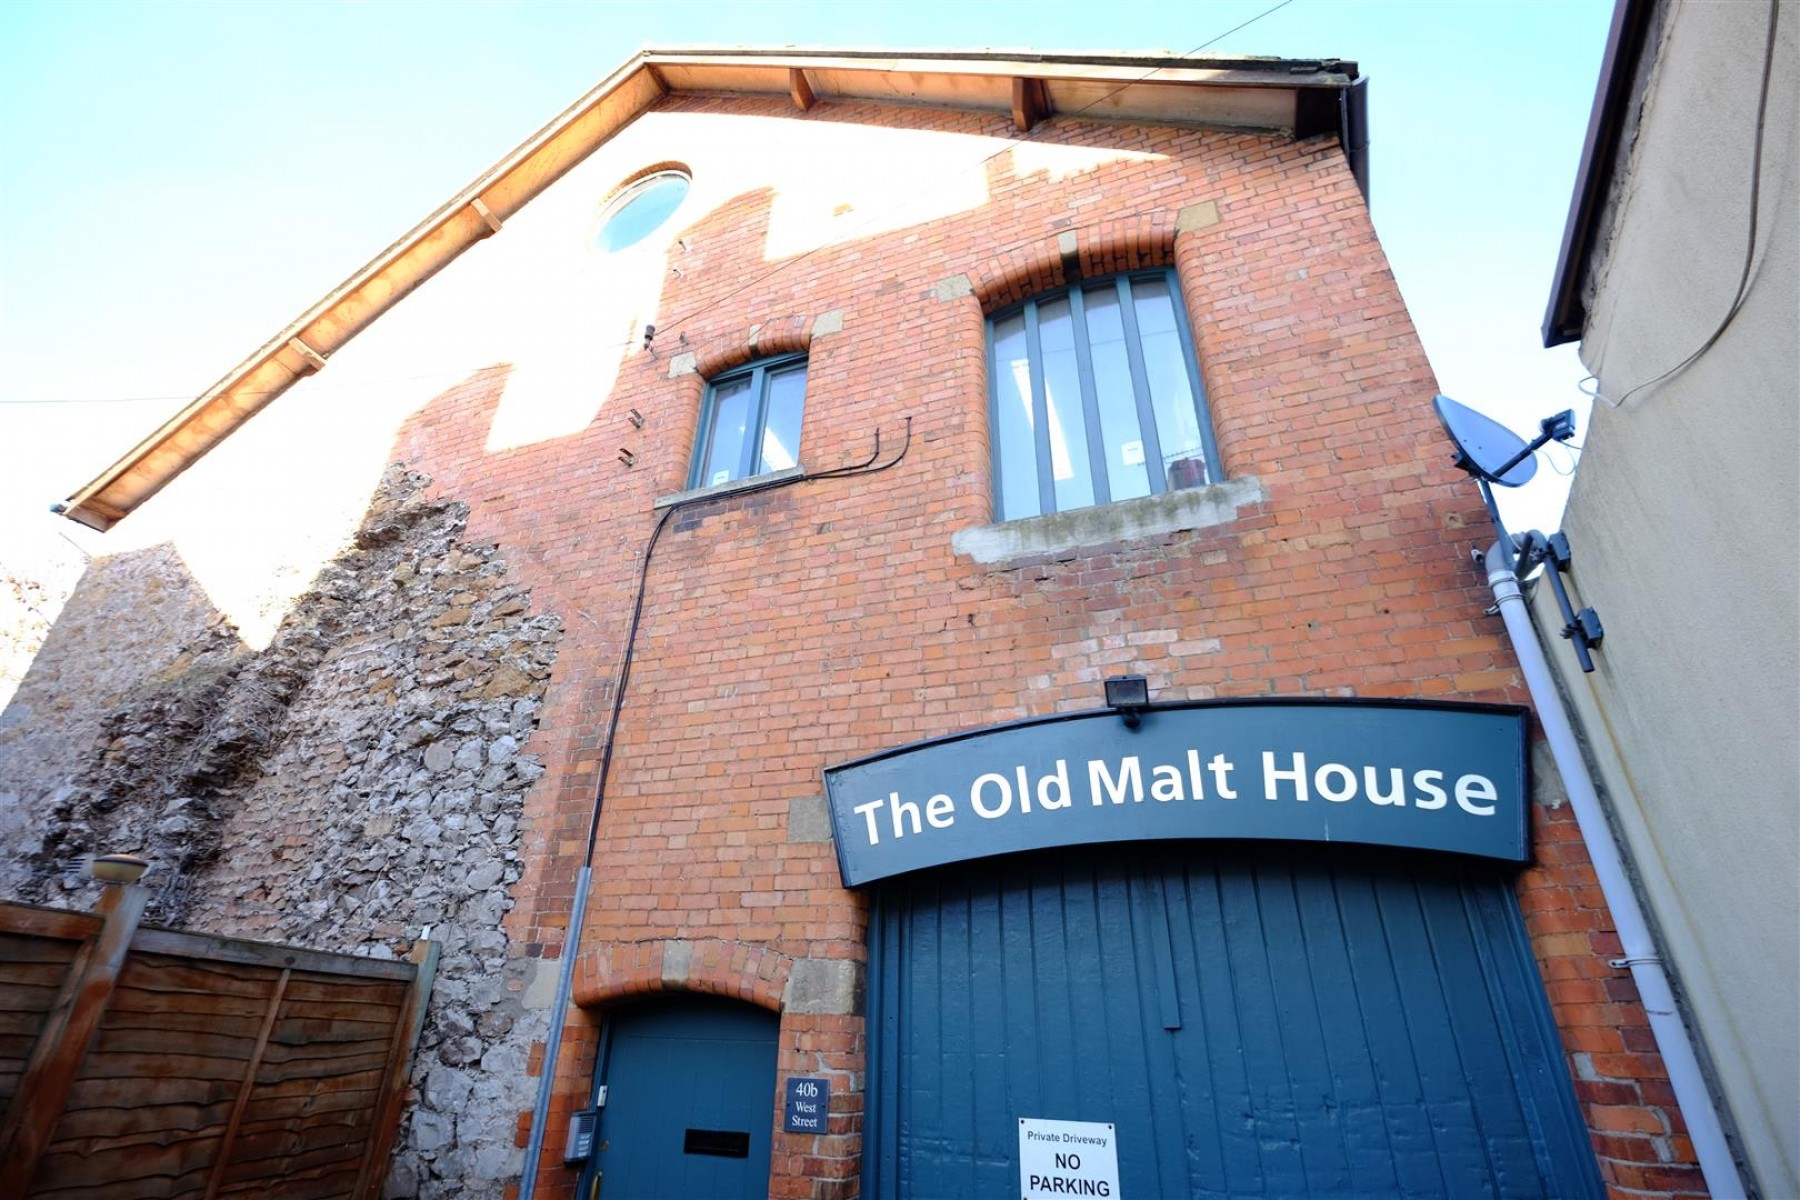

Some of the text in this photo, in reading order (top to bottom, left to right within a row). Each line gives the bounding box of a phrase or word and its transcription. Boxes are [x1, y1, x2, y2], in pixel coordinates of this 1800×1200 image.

[855, 750, 1498, 845] The Old Malt House
[796, 1082, 818, 1097] 40b
[795, 1101, 816, 1112] West
[792, 1115, 817, 1127] Street
[1027, 1130, 1107, 1147] Private Driveway
[1055, 1152, 1081, 1170] NO
[1030, 1175, 1110, 1197] PARKING
